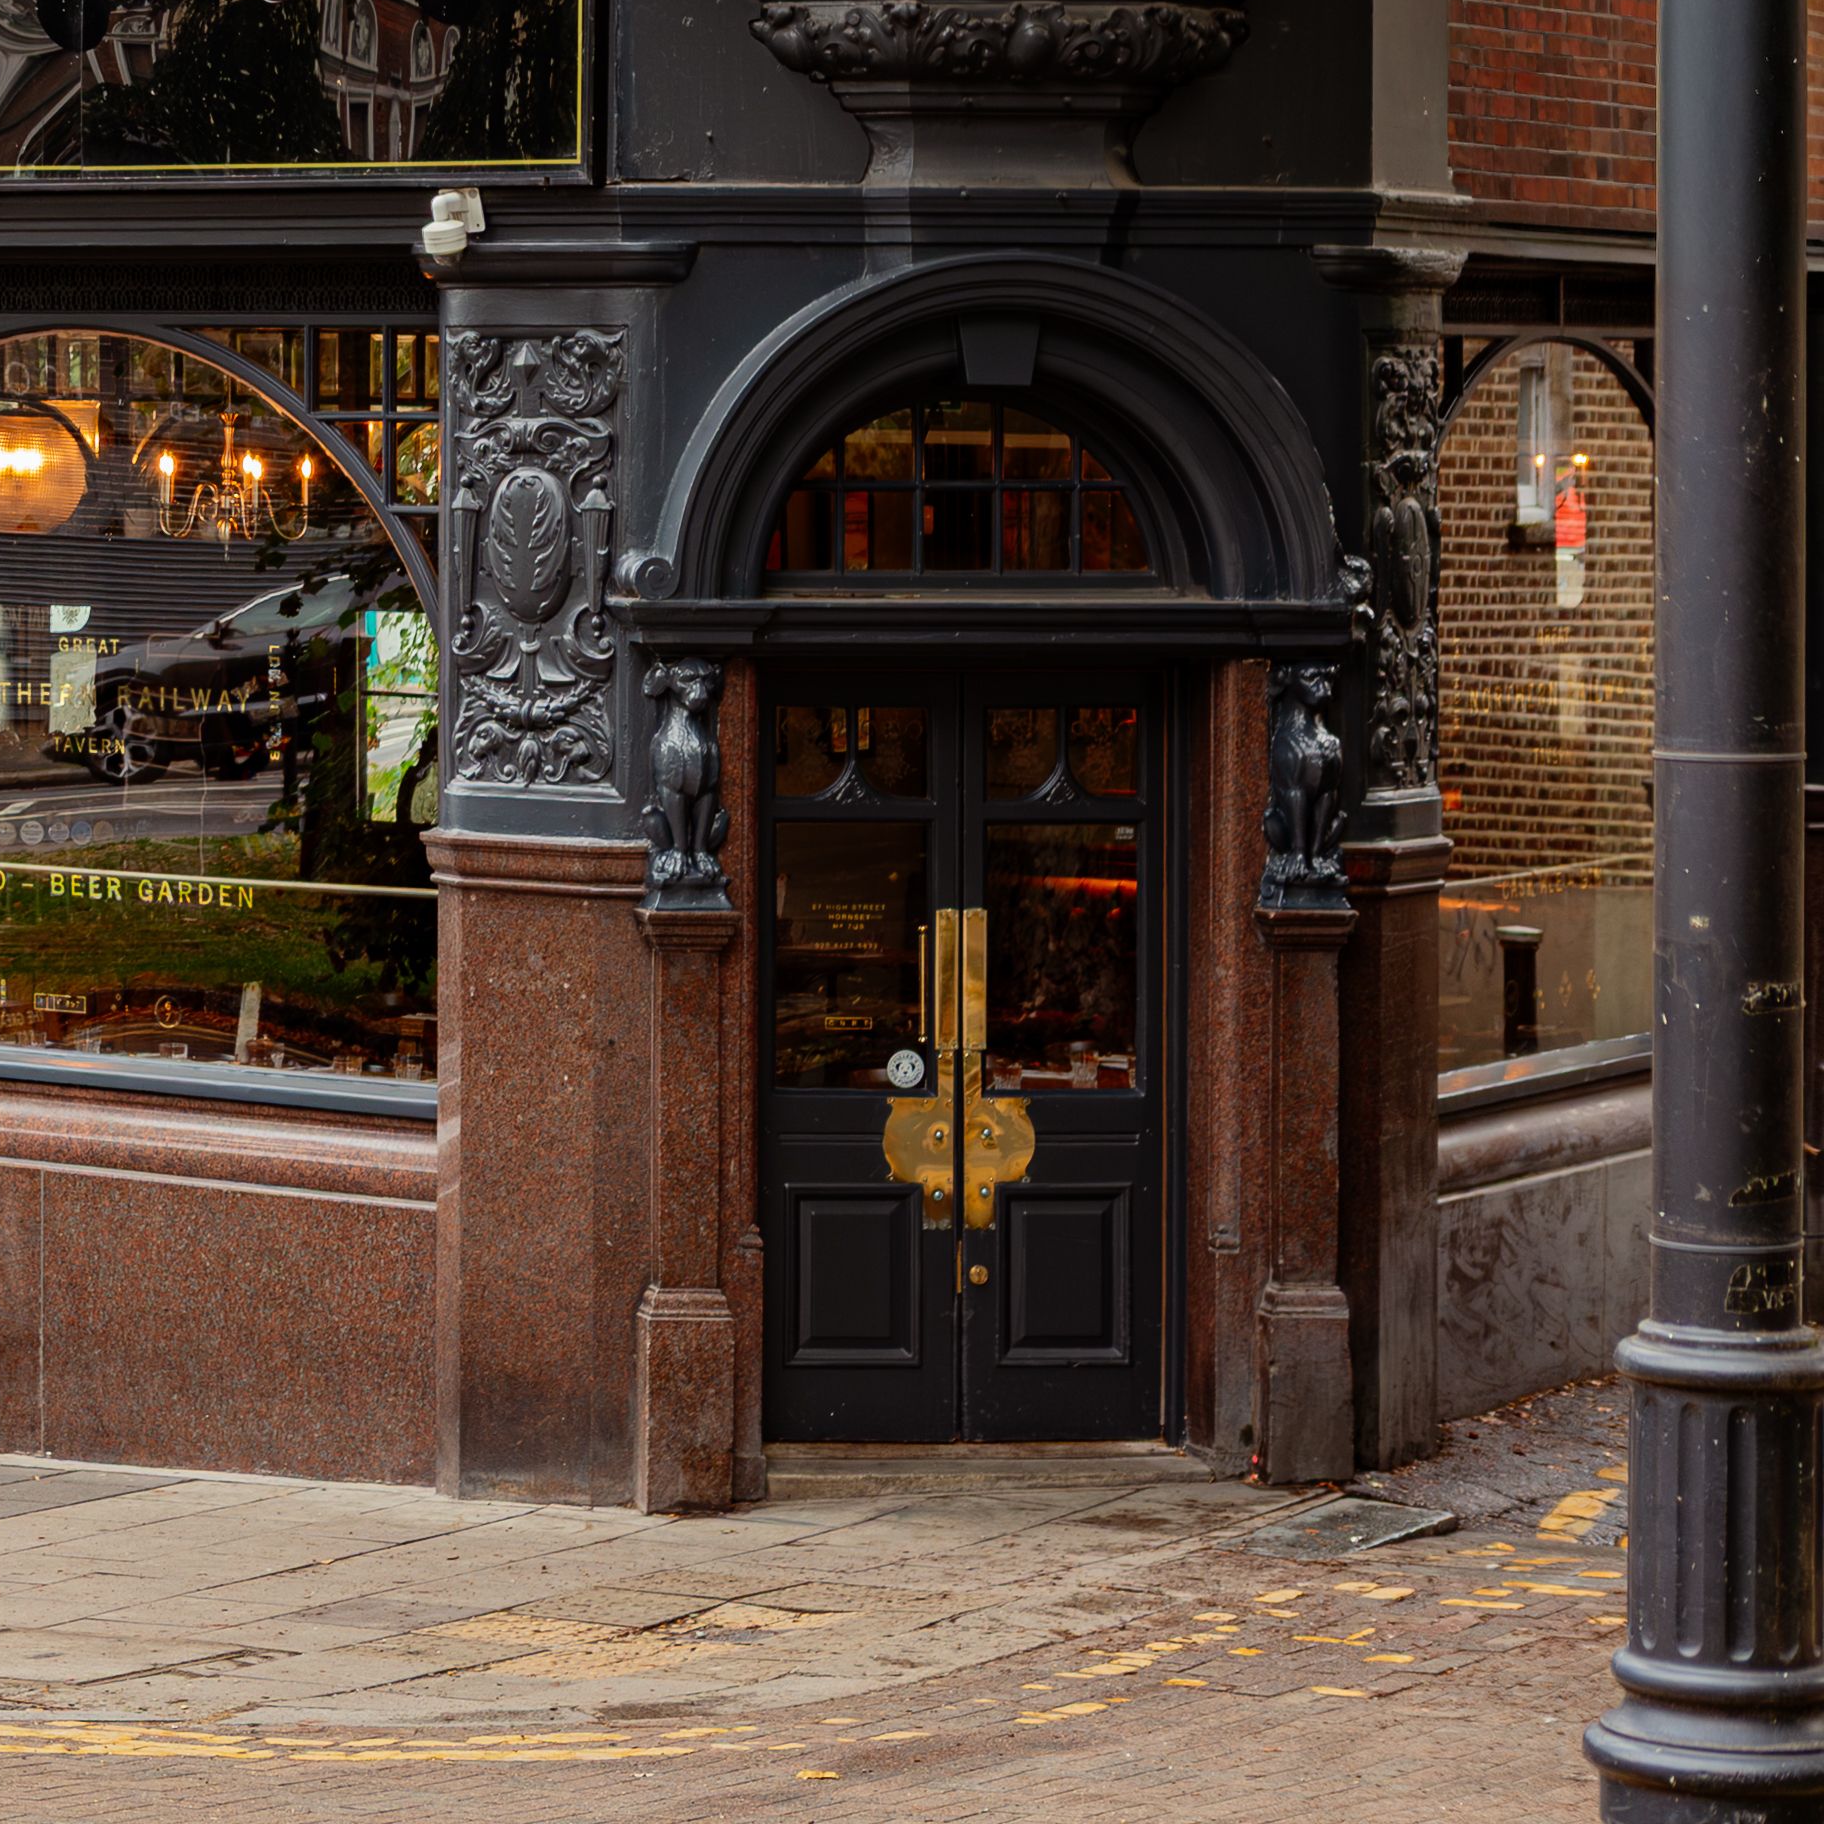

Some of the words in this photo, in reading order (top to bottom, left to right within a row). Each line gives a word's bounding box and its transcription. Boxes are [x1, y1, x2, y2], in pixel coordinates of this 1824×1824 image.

[58, 636, 120, 655] GREAT
[117, 685, 251, 714] RAILWAY
[54, 735, 125, 755] TAVERN
[50, 872, 122, 902] BEER
[138, 877, 254, 910] GARDEN
[826, 903, 848, 911] HIGH
[852, 903, 886, 911] STREET
